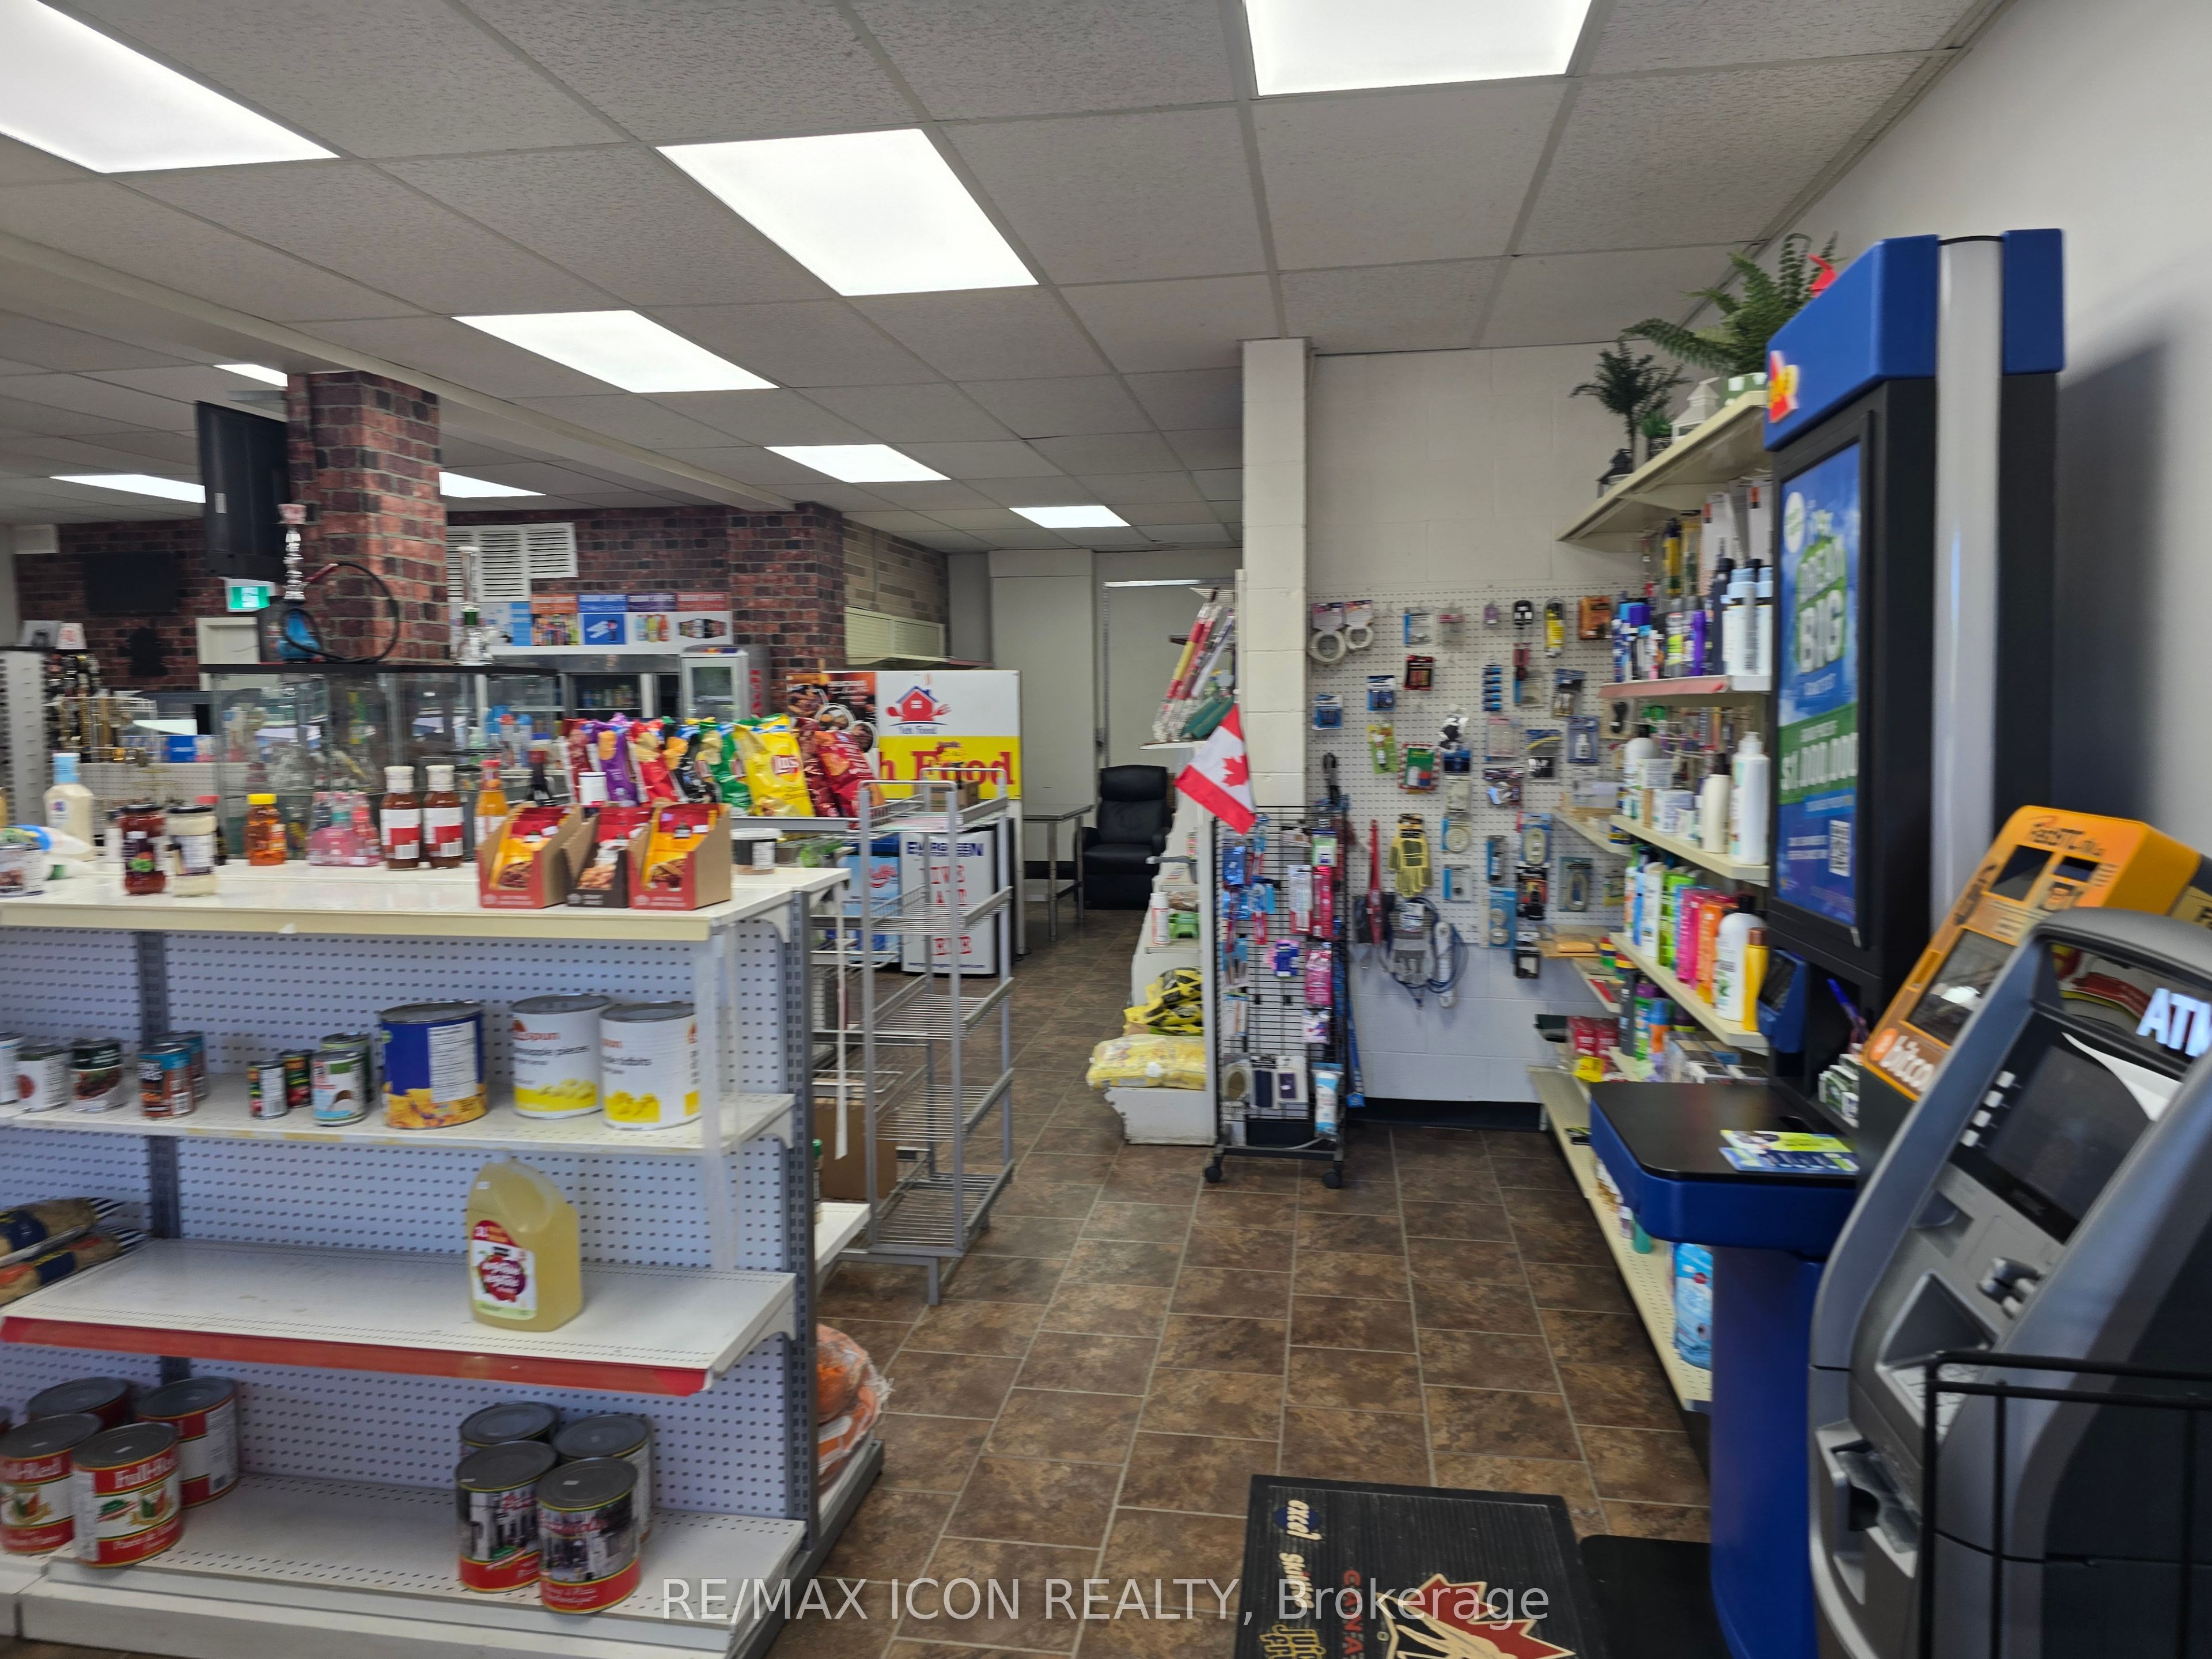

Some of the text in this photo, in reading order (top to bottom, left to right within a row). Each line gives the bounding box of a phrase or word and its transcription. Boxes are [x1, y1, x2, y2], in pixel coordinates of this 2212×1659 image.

[1800, 589, 1845, 674] BIG
[906, 841, 984, 857] EVRGEEN
[1286, 1499, 1323, 1540] excel
[1343, 1569, 1364, 1657] CANA
